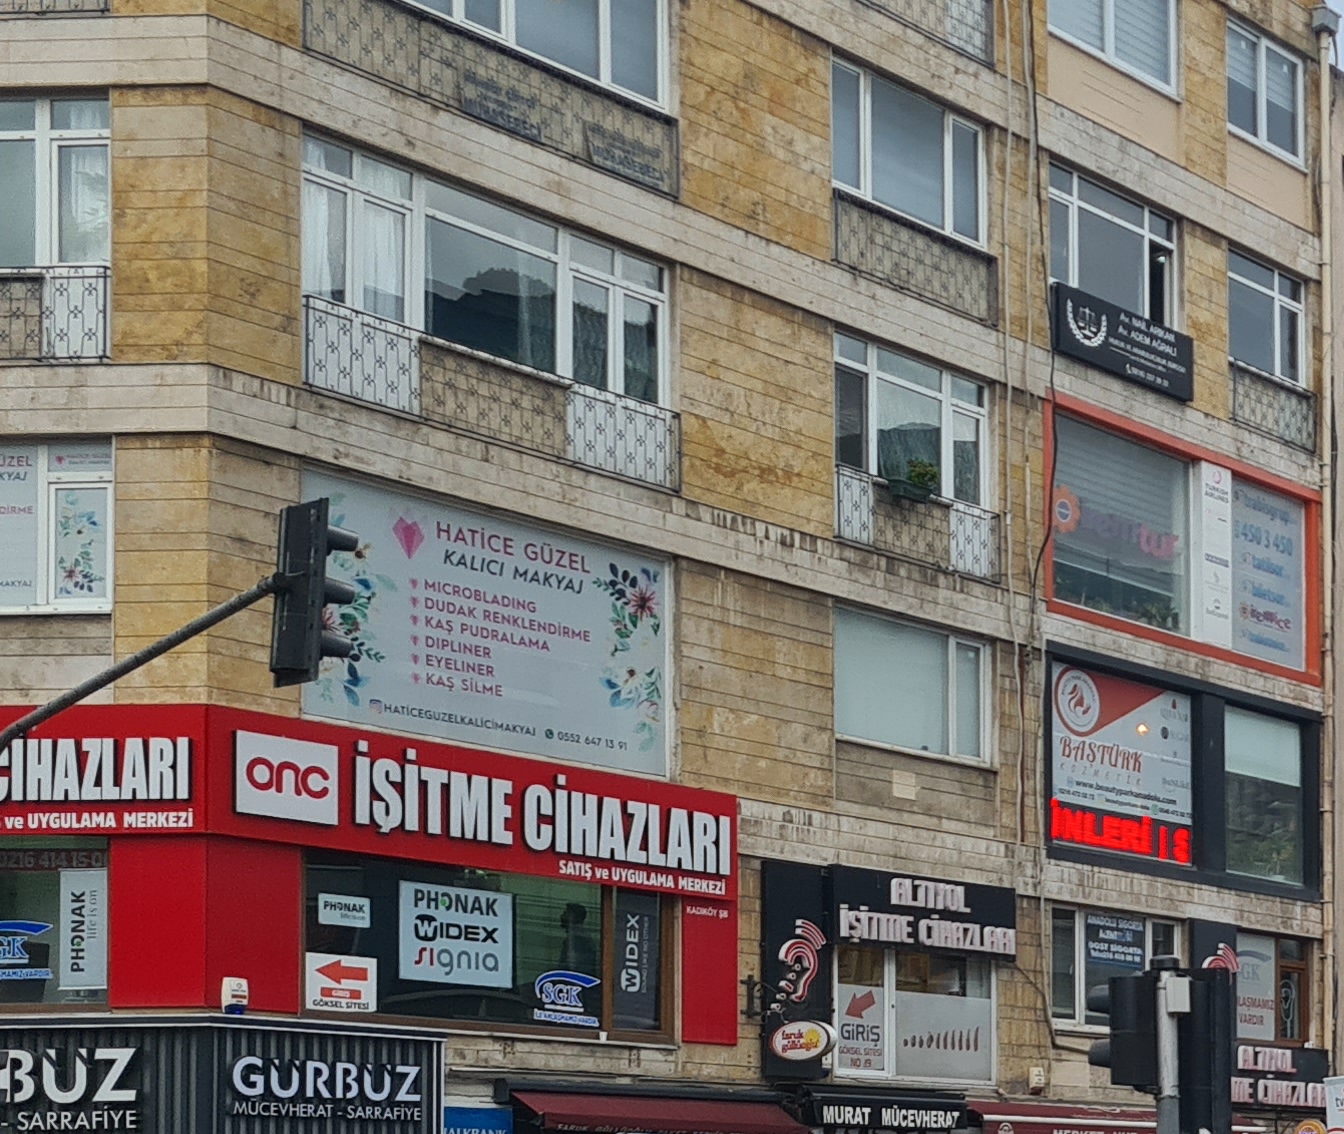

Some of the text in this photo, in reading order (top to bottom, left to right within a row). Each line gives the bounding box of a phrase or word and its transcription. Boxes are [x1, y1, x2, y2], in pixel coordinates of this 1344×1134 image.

[436, 521, 592, 574] HATİCE GÜZEL
[443, 549, 584, 595] KALICI MAKYAJ
[424, 579, 537, 613] MICROBLADING
[424, 597, 591, 642] DUDAK RENKLENDİRME
[424, 615, 550, 652] KAŞ PUDRALAMA
[425, 654, 495, 677] EYELINER
[426, 673, 503, 697] KAŞ SİLME
[557, 731, 580, 744] 0552
[5, 808, 193, 829] ve UYGULAMA MERKEZİ
[355, 740, 731, 876] İŞİTME CİHAZLARI
[559, 860, 726, 895] SATIŞ ve UYGULAMA MERKEZİ
[323, 900, 366, 914] PHONAK
[413, 888, 498, 917] PHONAK
[70, 890, 86, 972] PHONAK
[413, 914, 499, 943] WIDEX
[620, 913, 641, 993] WIDEX
[543, 983, 582, 1006] SGK
[17, 1105, 137, 1131] SARRAFİYE
[233, 1099, 421, 1121] MÜCEVHERAT SARRAFİYE
[823, 1105, 961, 1129] MURAT MÜCEVHERAT
